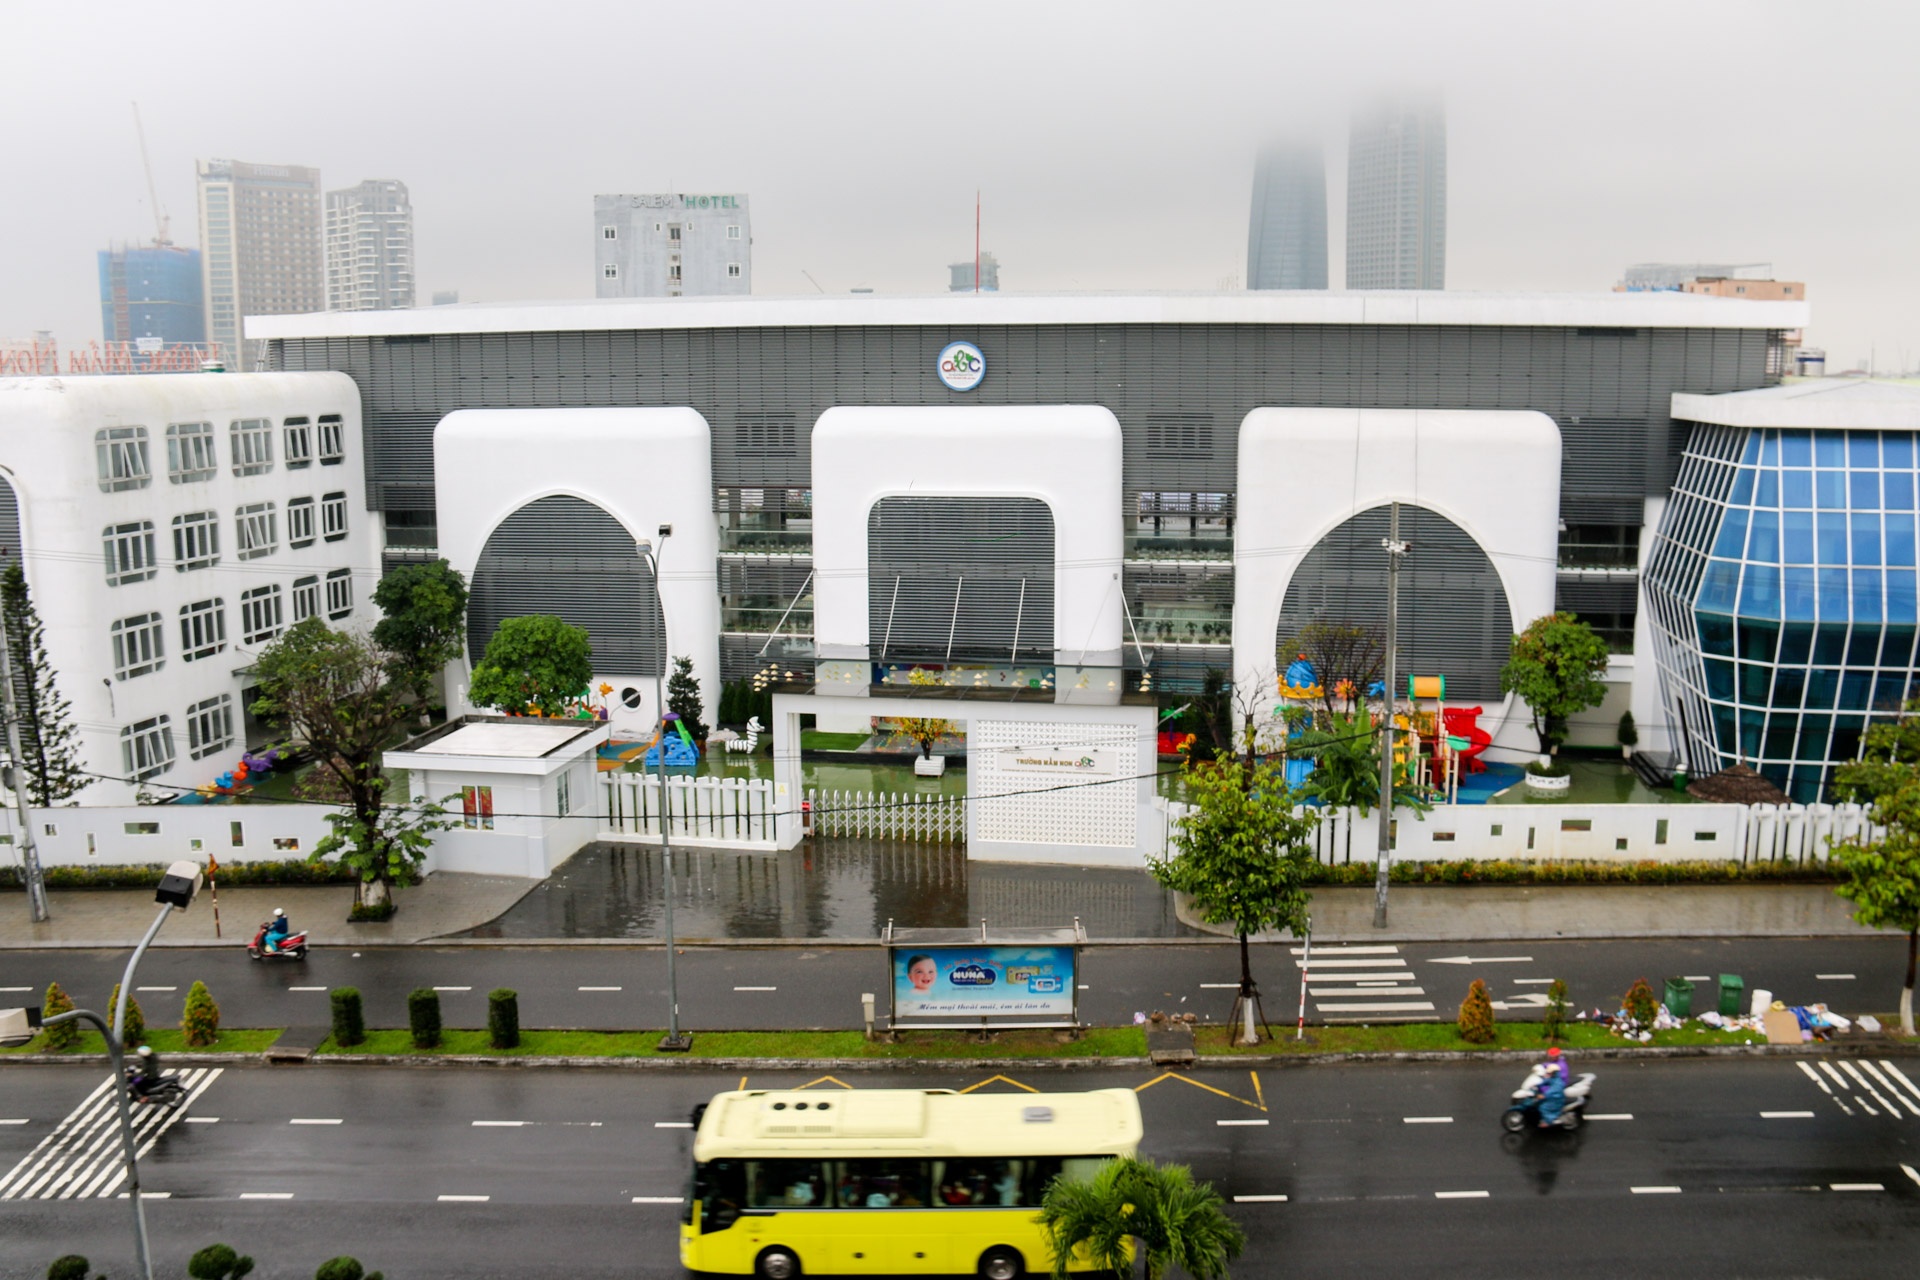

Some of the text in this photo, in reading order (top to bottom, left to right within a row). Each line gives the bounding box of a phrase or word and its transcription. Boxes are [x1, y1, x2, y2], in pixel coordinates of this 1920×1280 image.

[631, 194, 739, 209] SALEM HOTEL
[1059, 759, 1073, 767] NON
[953, 971, 985, 980] NUNA
